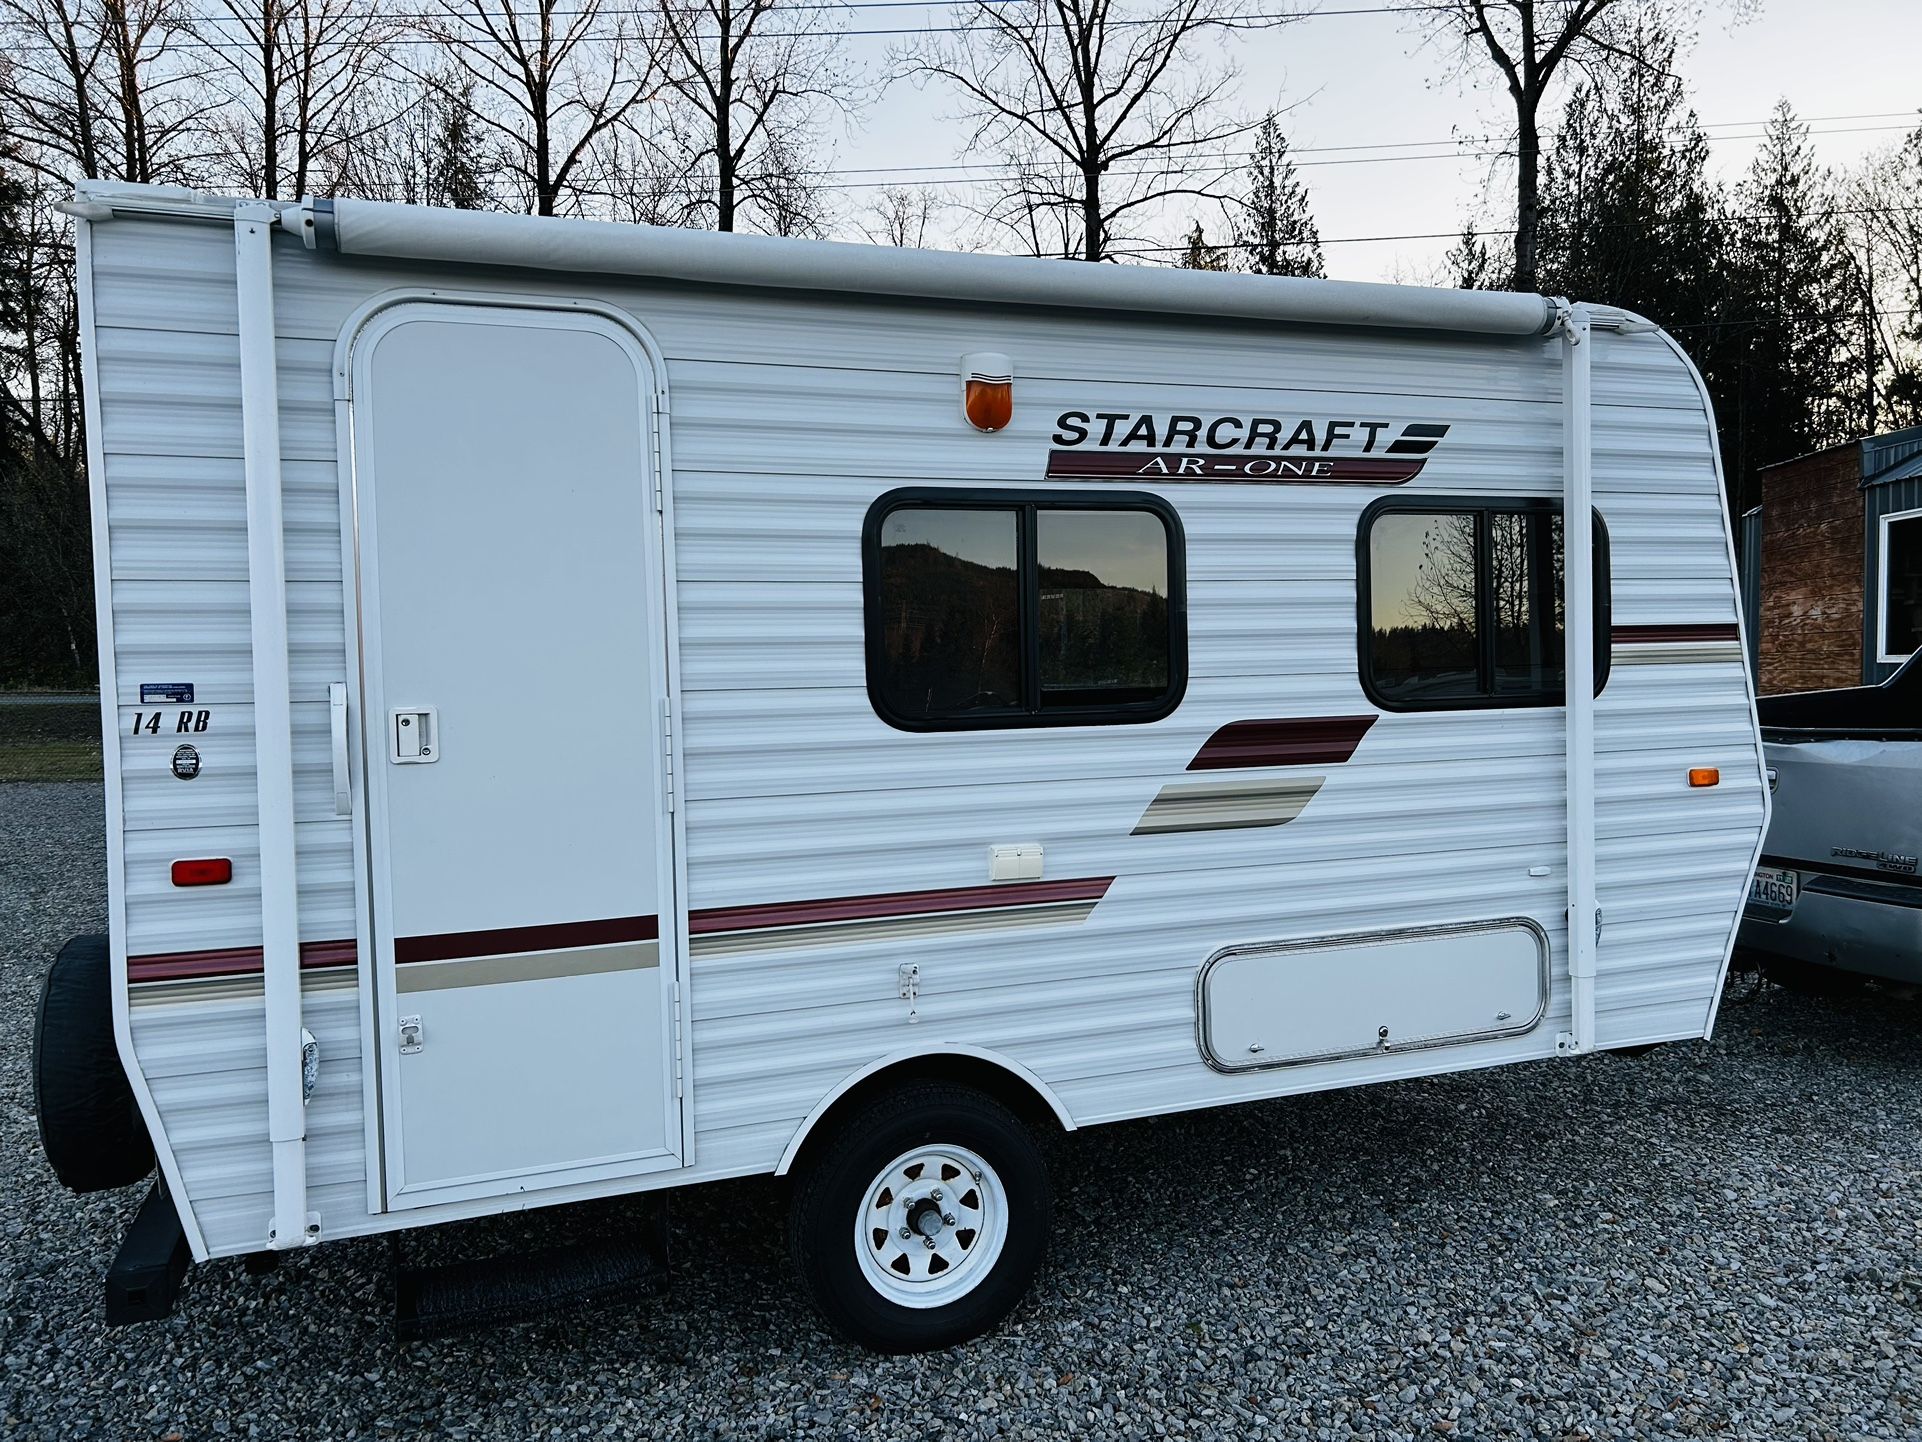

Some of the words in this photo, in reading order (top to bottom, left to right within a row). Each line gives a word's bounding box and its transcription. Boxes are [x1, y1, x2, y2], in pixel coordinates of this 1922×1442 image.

[1051, 411, 1390, 453] STARCRAFT
[133, 711, 162, 735] 14
[176, 710, 210, 733] RB
[1831, 846, 1918, 865] RIDGELINE
[1749, 879, 1793, 905] A4669
